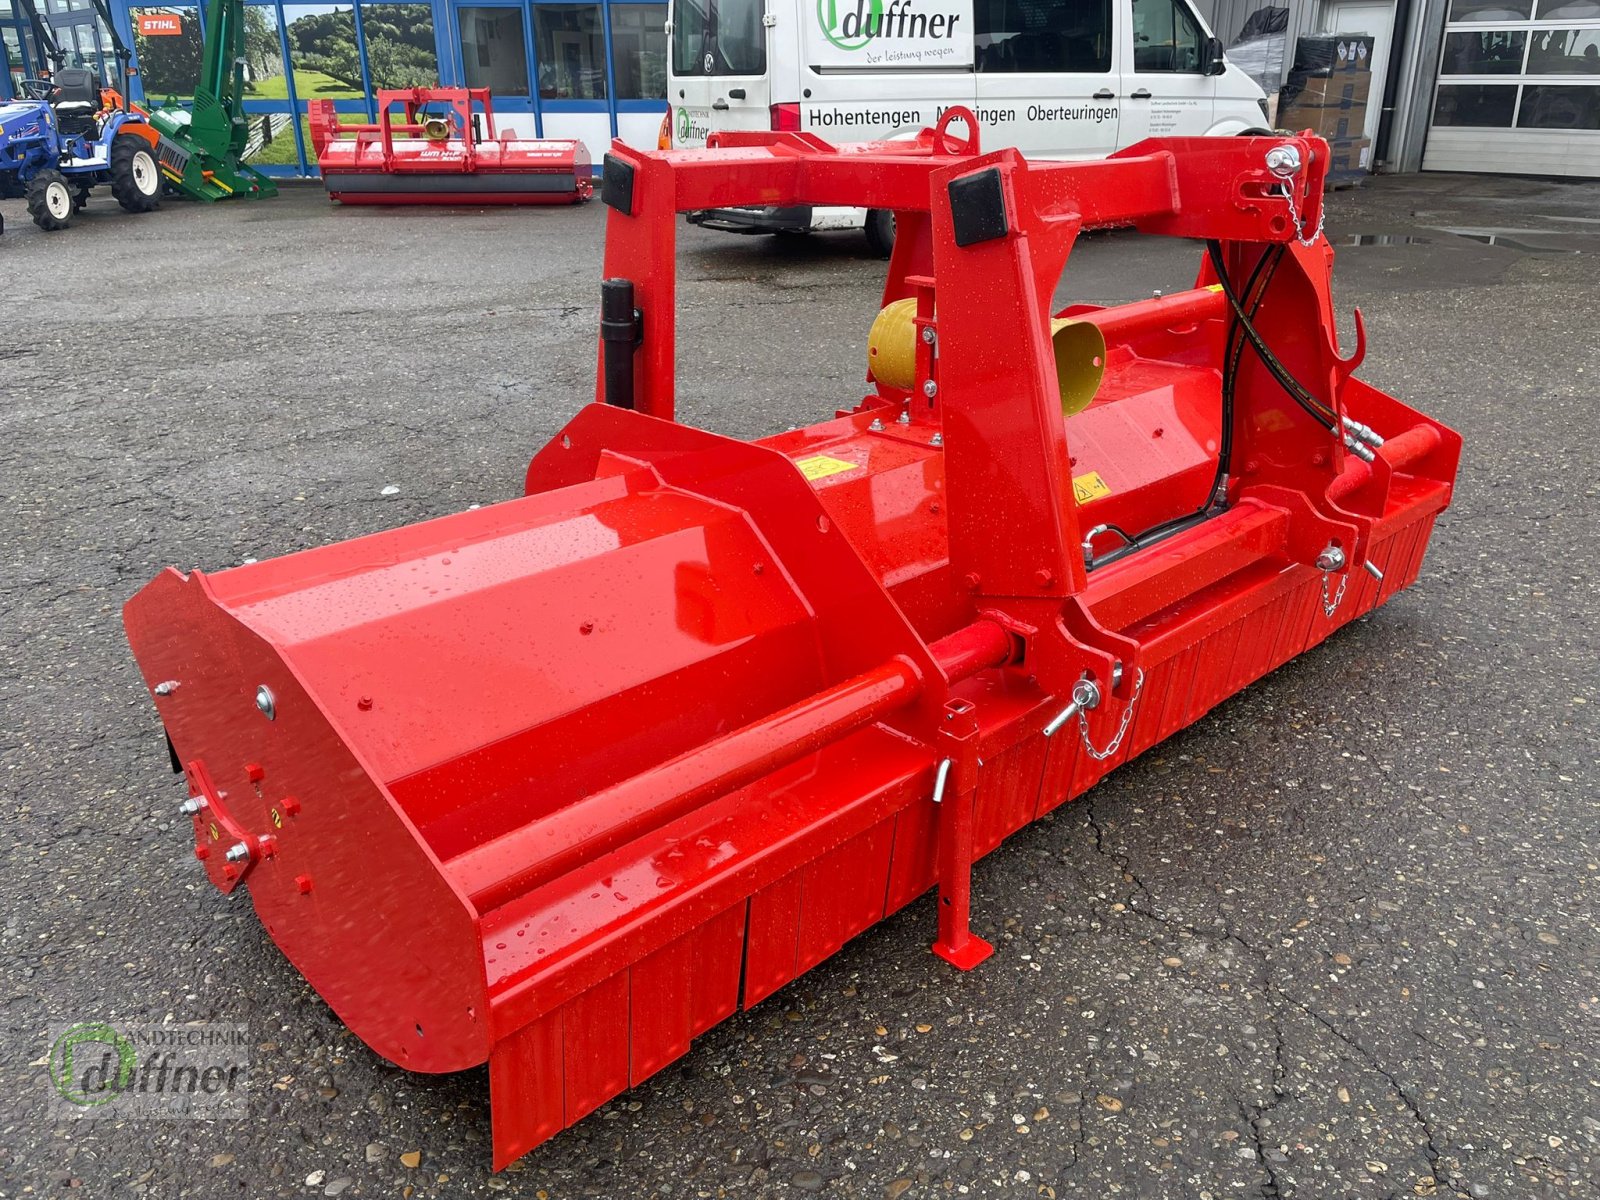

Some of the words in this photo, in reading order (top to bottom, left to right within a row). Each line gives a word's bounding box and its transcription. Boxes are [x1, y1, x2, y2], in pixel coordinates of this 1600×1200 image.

[143, 20, 177, 30] STIHL
[842, 0, 960, 39] duffner
[866, 52, 882, 64] der
[885, 49, 922, 62] leistung
[924, 47, 955, 59] wegen
[809, 107, 921, 129] Hohentengen
[936, 105, 1016, 126] Mingen
[1026, 104, 1118, 122] Oberteuringen
[680, 119, 710, 140] duffner
